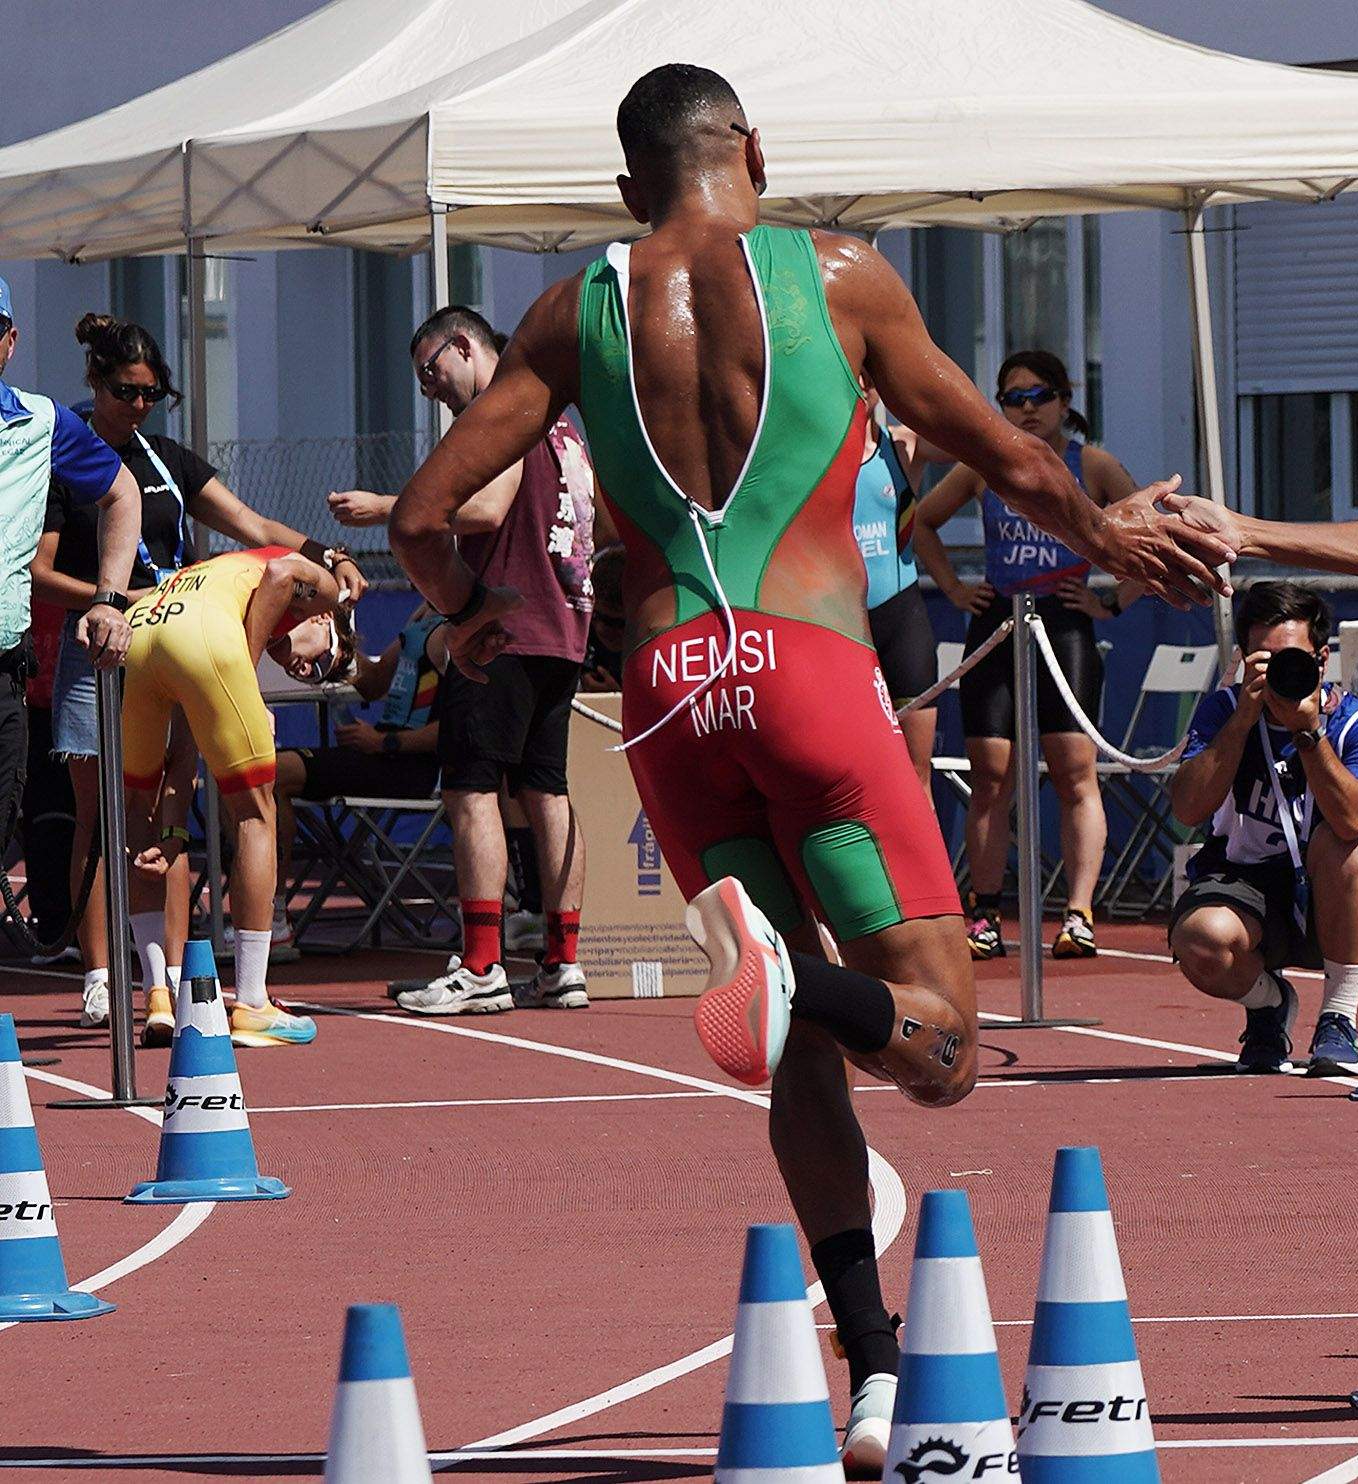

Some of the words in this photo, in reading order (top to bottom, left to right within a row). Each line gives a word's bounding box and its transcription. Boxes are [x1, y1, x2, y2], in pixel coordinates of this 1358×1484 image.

[857, 538, 890, 558] EL
[1003, 543, 1059, 567] JPN
[150, 574, 206, 594] ARTIN
[129, 601, 185, 629] ESP
[652, 629, 777, 688] NEMSI
[689, 685, 758, 737] MAR
[176, 1093, 244, 1111] Fet
[0, 1200, 54, 1221] etr
